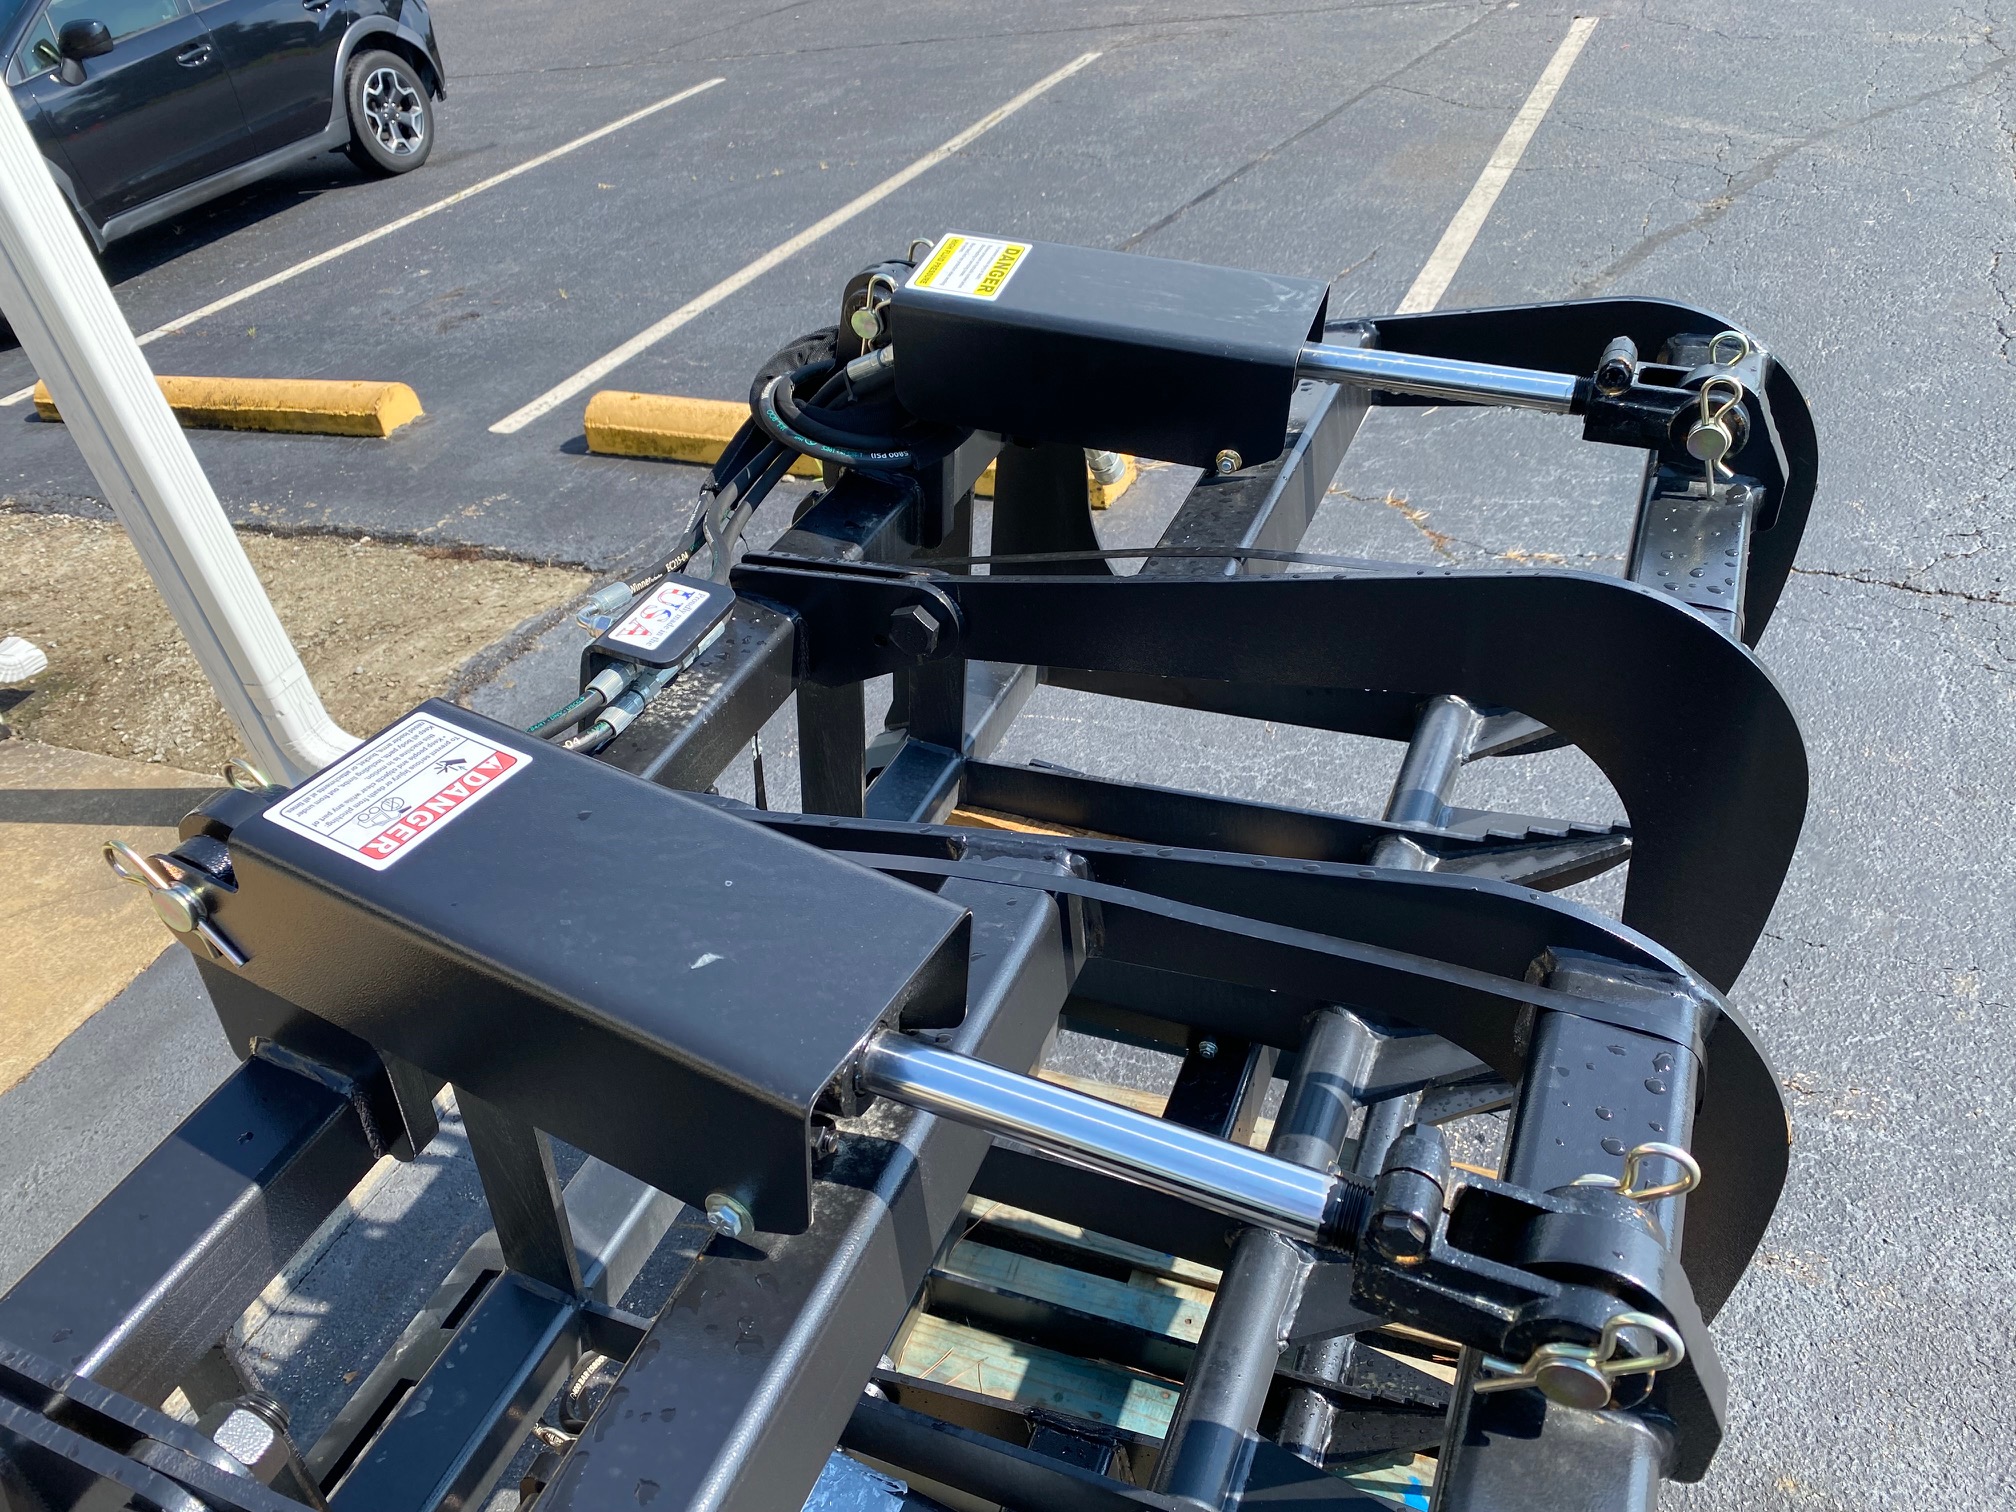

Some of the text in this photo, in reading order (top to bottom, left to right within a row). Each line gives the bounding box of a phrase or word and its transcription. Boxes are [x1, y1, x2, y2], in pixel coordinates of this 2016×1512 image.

[937, 250, 951, 262] FLUID
[919, 262, 942, 284] PRESSURE
[977, 248, 1021, 292] DANGER
[630, 576, 652, 593] Winner
[665, 551, 689, 573] EC215-04
[678, 593, 706, 614] Proudly
[615, 589, 696, 637] USA
[663, 614, 682, 630] made
[646, 637, 659, 646] the
[408, 722, 425, 734] raised
[418, 725, 435, 735] Keep
[392, 732, 411, 744] loader
[397, 739, 414, 749] body
[427, 737, 444, 748] Keep
[399, 741, 424, 757] machine
[408, 746, 428, 761] people
[429, 740, 452, 756] prevent
[356, 752, 379, 766] bucket,
[396, 760, 409, 769] and
[408, 755, 431, 770] serious
[355, 758, 384, 777] including
[364, 765, 388, 780] motion.
[316, 770, 351, 793] attachments
[337, 776, 358, 787] limbs,
[375, 768, 398, 783] objects
[391, 769, 411, 782] injury
[327, 788, 340, 796] out
[360, 782, 376, 794] clear
[367, 786, 386, 798] death
[314, 794, 330, 805] from
[343, 793, 362, 804] while
[353, 797, 370, 808] from
[285, 801, 305, 813] times.
[296, 804, 315, 817] under
[332, 803, 345, 813] any
[367, 770, 490, 853] DANGER
[318, 811, 333, 822] part
[324, 806, 354, 828] pinching:
